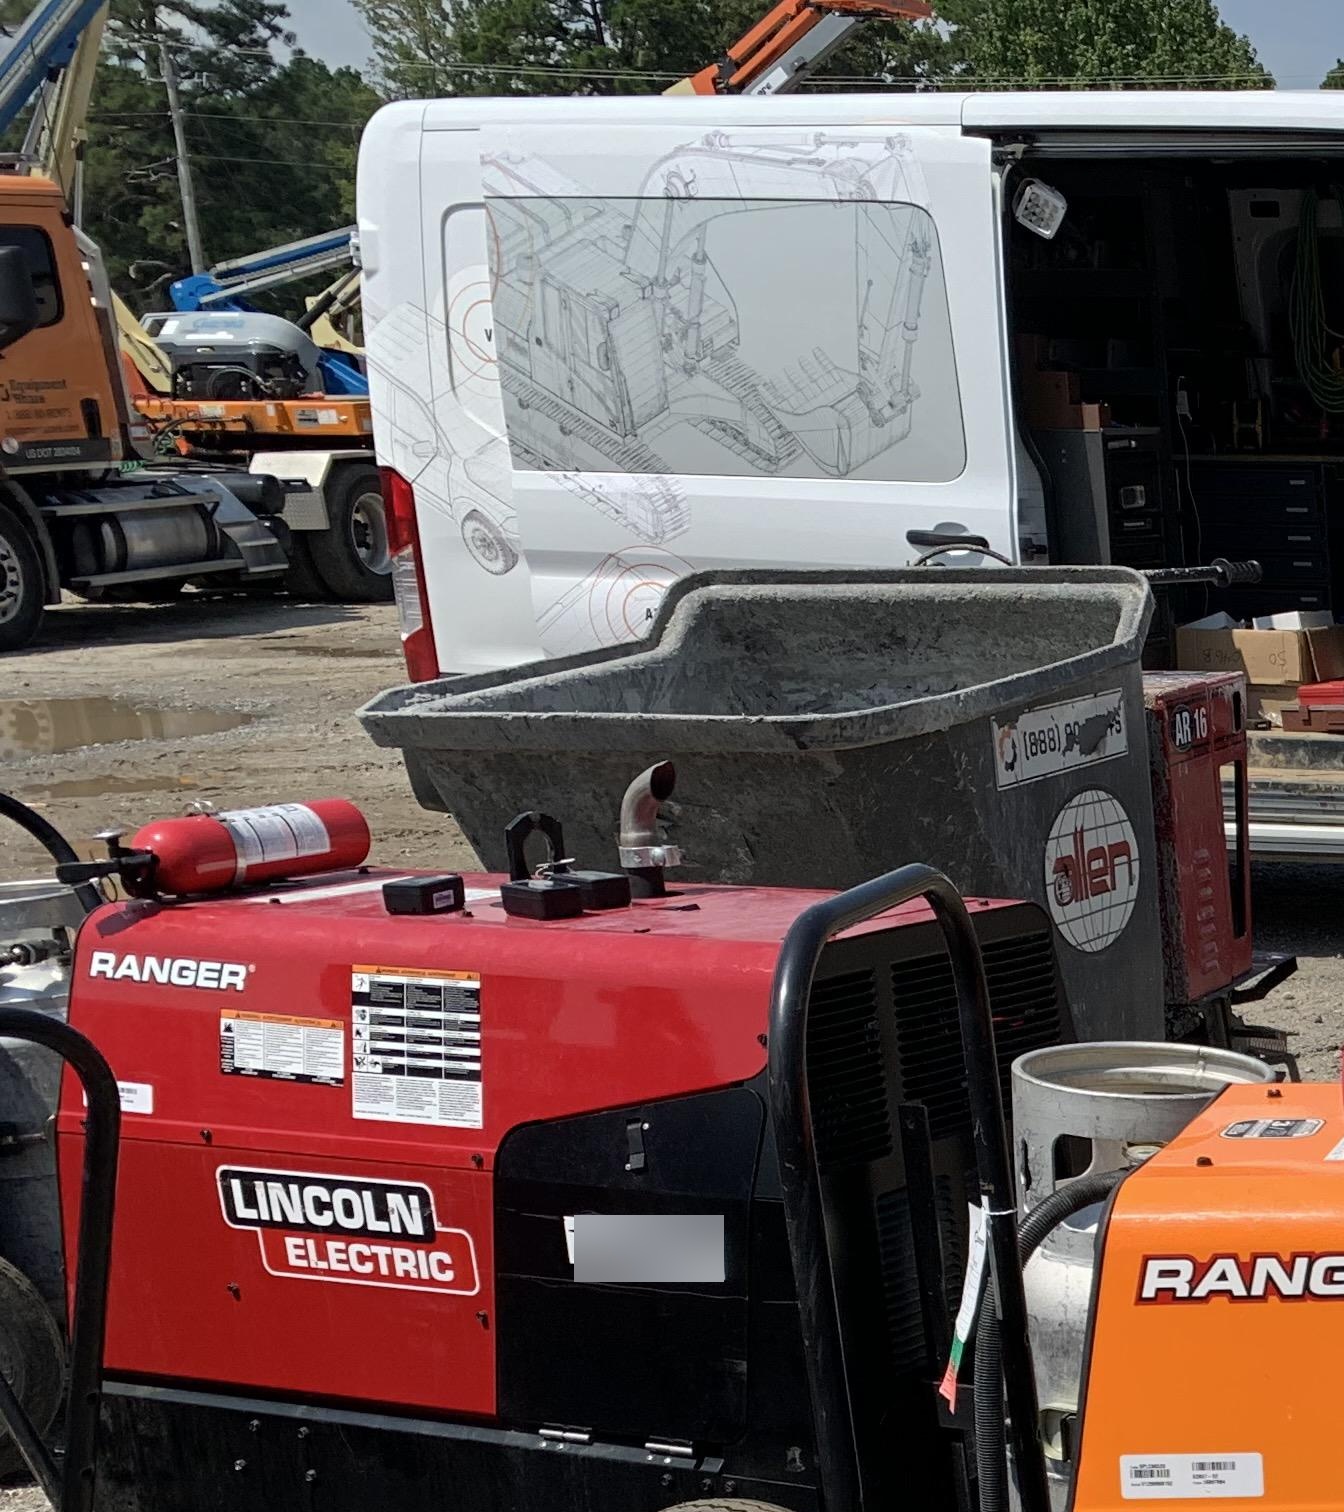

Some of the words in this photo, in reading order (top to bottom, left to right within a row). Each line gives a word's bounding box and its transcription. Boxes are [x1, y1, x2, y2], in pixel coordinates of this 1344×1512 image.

[1023, 724, 1062, 761] (888)
[1175, 712, 1192, 747] AR
[1193, 706, 1208, 739] 16
[89, 950, 248, 992] RANGER
[230, 1178, 426, 1237] LINCOLN
[283, 1236, 456, 1283] ELECTRIC
